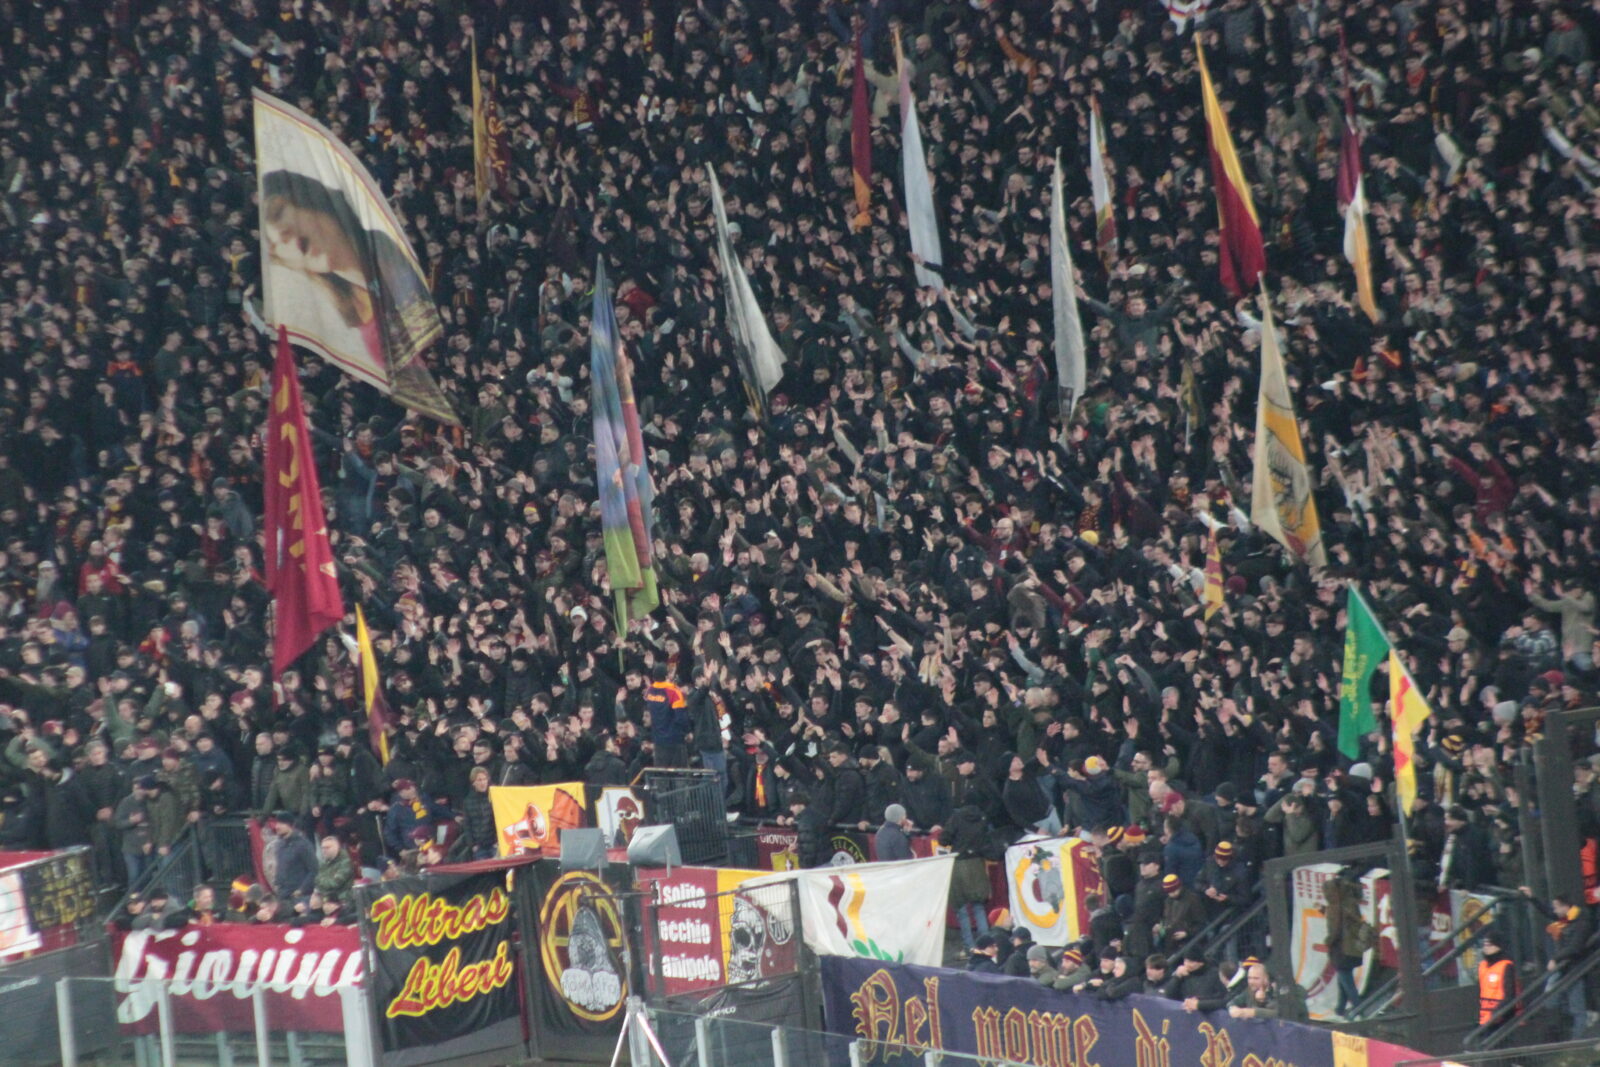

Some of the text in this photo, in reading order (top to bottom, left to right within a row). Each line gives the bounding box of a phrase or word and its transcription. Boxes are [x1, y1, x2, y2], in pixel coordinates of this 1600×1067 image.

[371, 887, 509, 951] Ultras
[662, 882, 707, 909] solito
[656, 917, 712, 945] ecchio
[386, 940, 513, 1018] Liberi
[850, 969, 944, 1064] Nel
[972, 1006, 1100, 1067] nome
[1132, 1008, 1171, 1067] di
